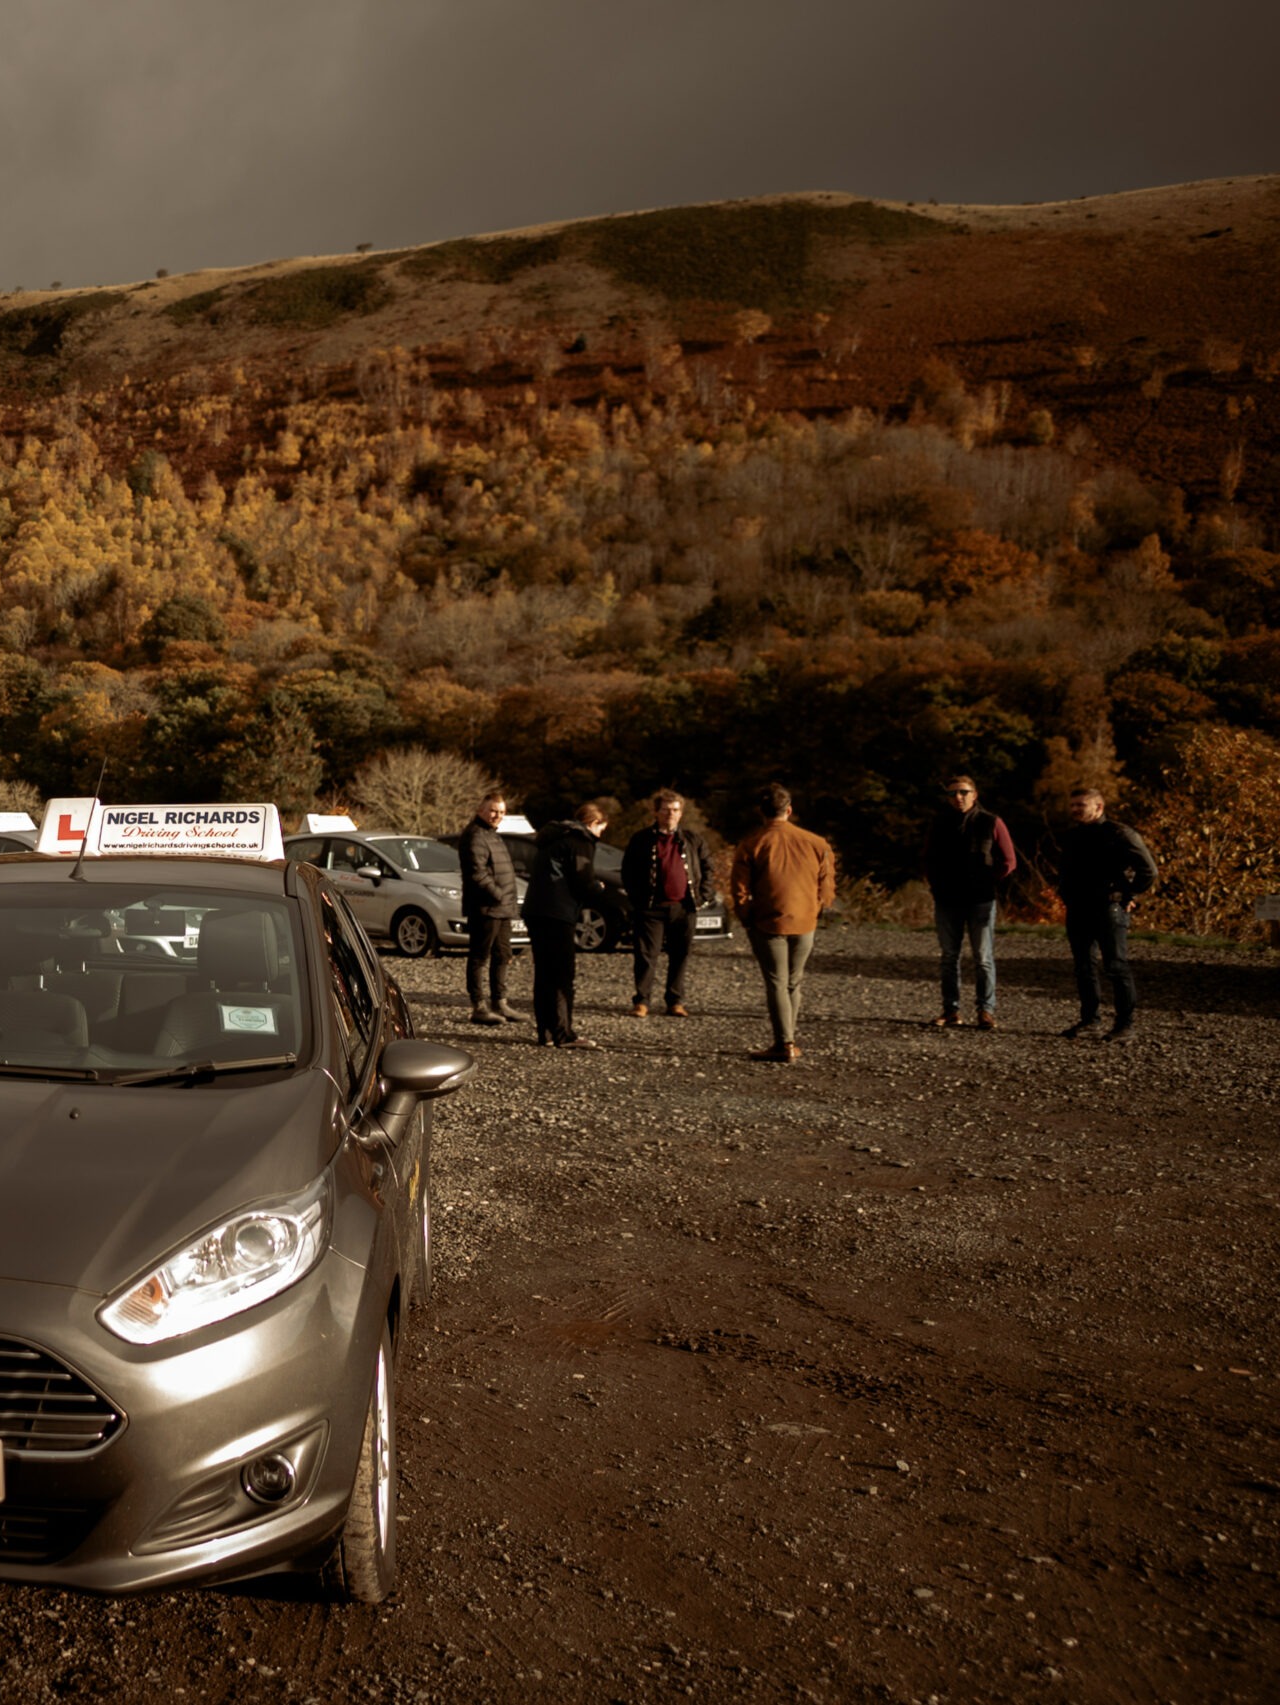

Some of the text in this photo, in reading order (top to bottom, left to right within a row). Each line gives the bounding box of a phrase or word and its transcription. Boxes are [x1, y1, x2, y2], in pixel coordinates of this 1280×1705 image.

[107, 810, 261, 825] NIGEL RICHARDS
[58, 814, 85, 840] L
[122, 825, 239, 839] Driving School
